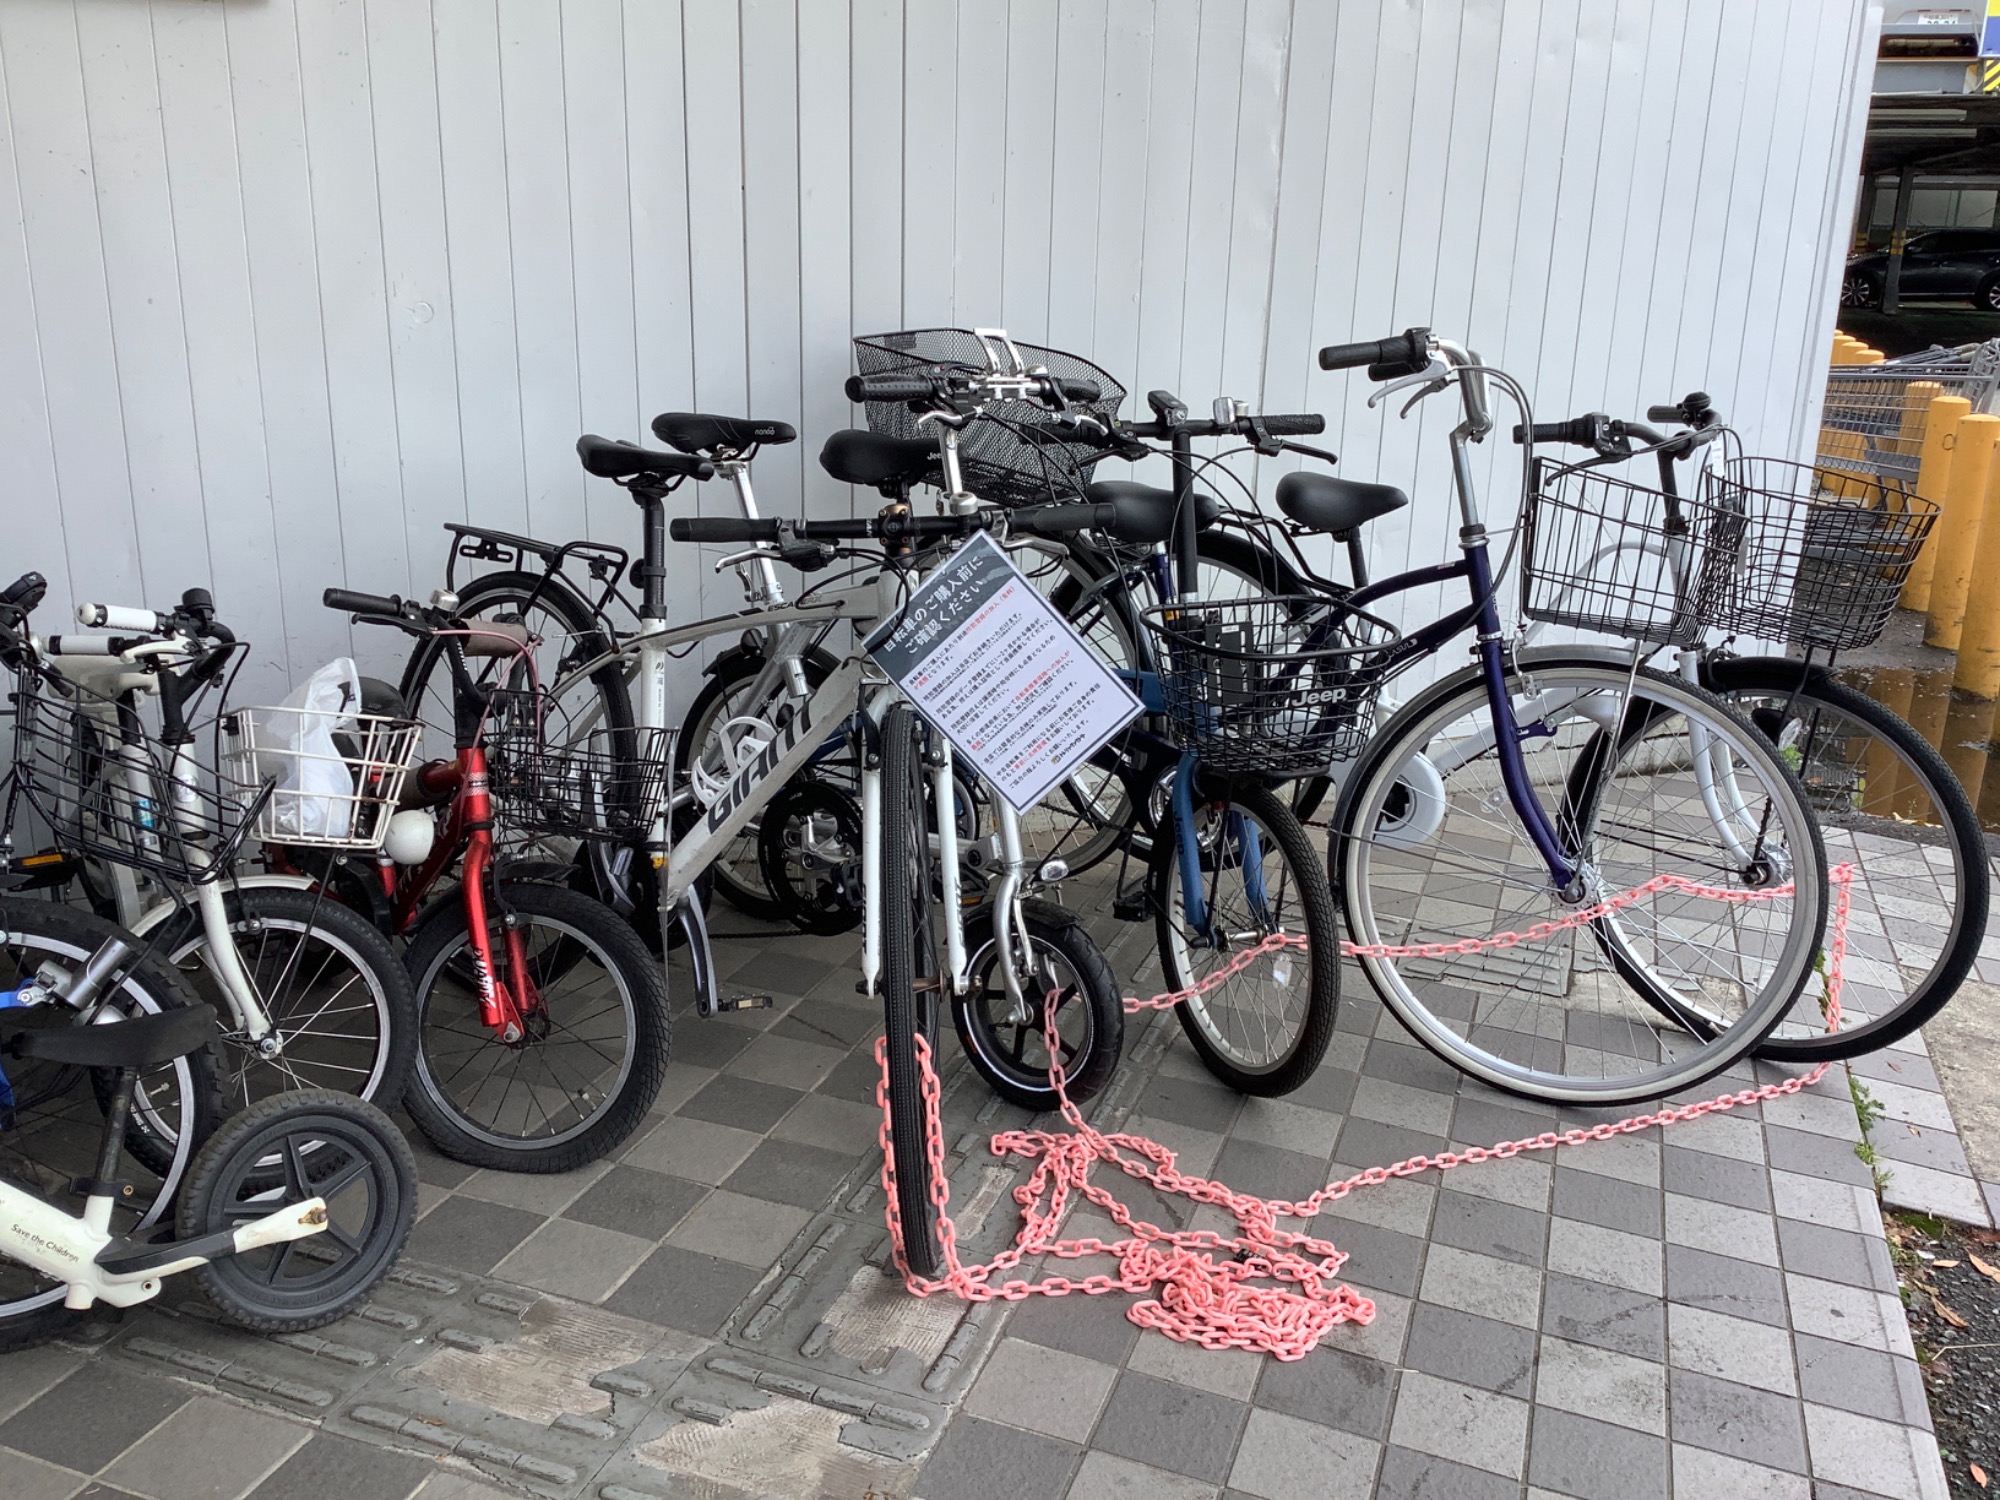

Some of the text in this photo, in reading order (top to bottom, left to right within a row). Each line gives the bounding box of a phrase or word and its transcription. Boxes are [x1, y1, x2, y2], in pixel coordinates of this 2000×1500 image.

[927, 451, 943, 461] Jee
[879, 552, 986, 653] 自転車のご購入前に
[902, 575, 987, 656] ご確認ください
[1291, 688, 1347, 707] Jeep
[705, 699, 813, 836] GIANT
[1174, 811, 1185, 855] Jeep
[11, 1223, 79, 1263] Save the Children
